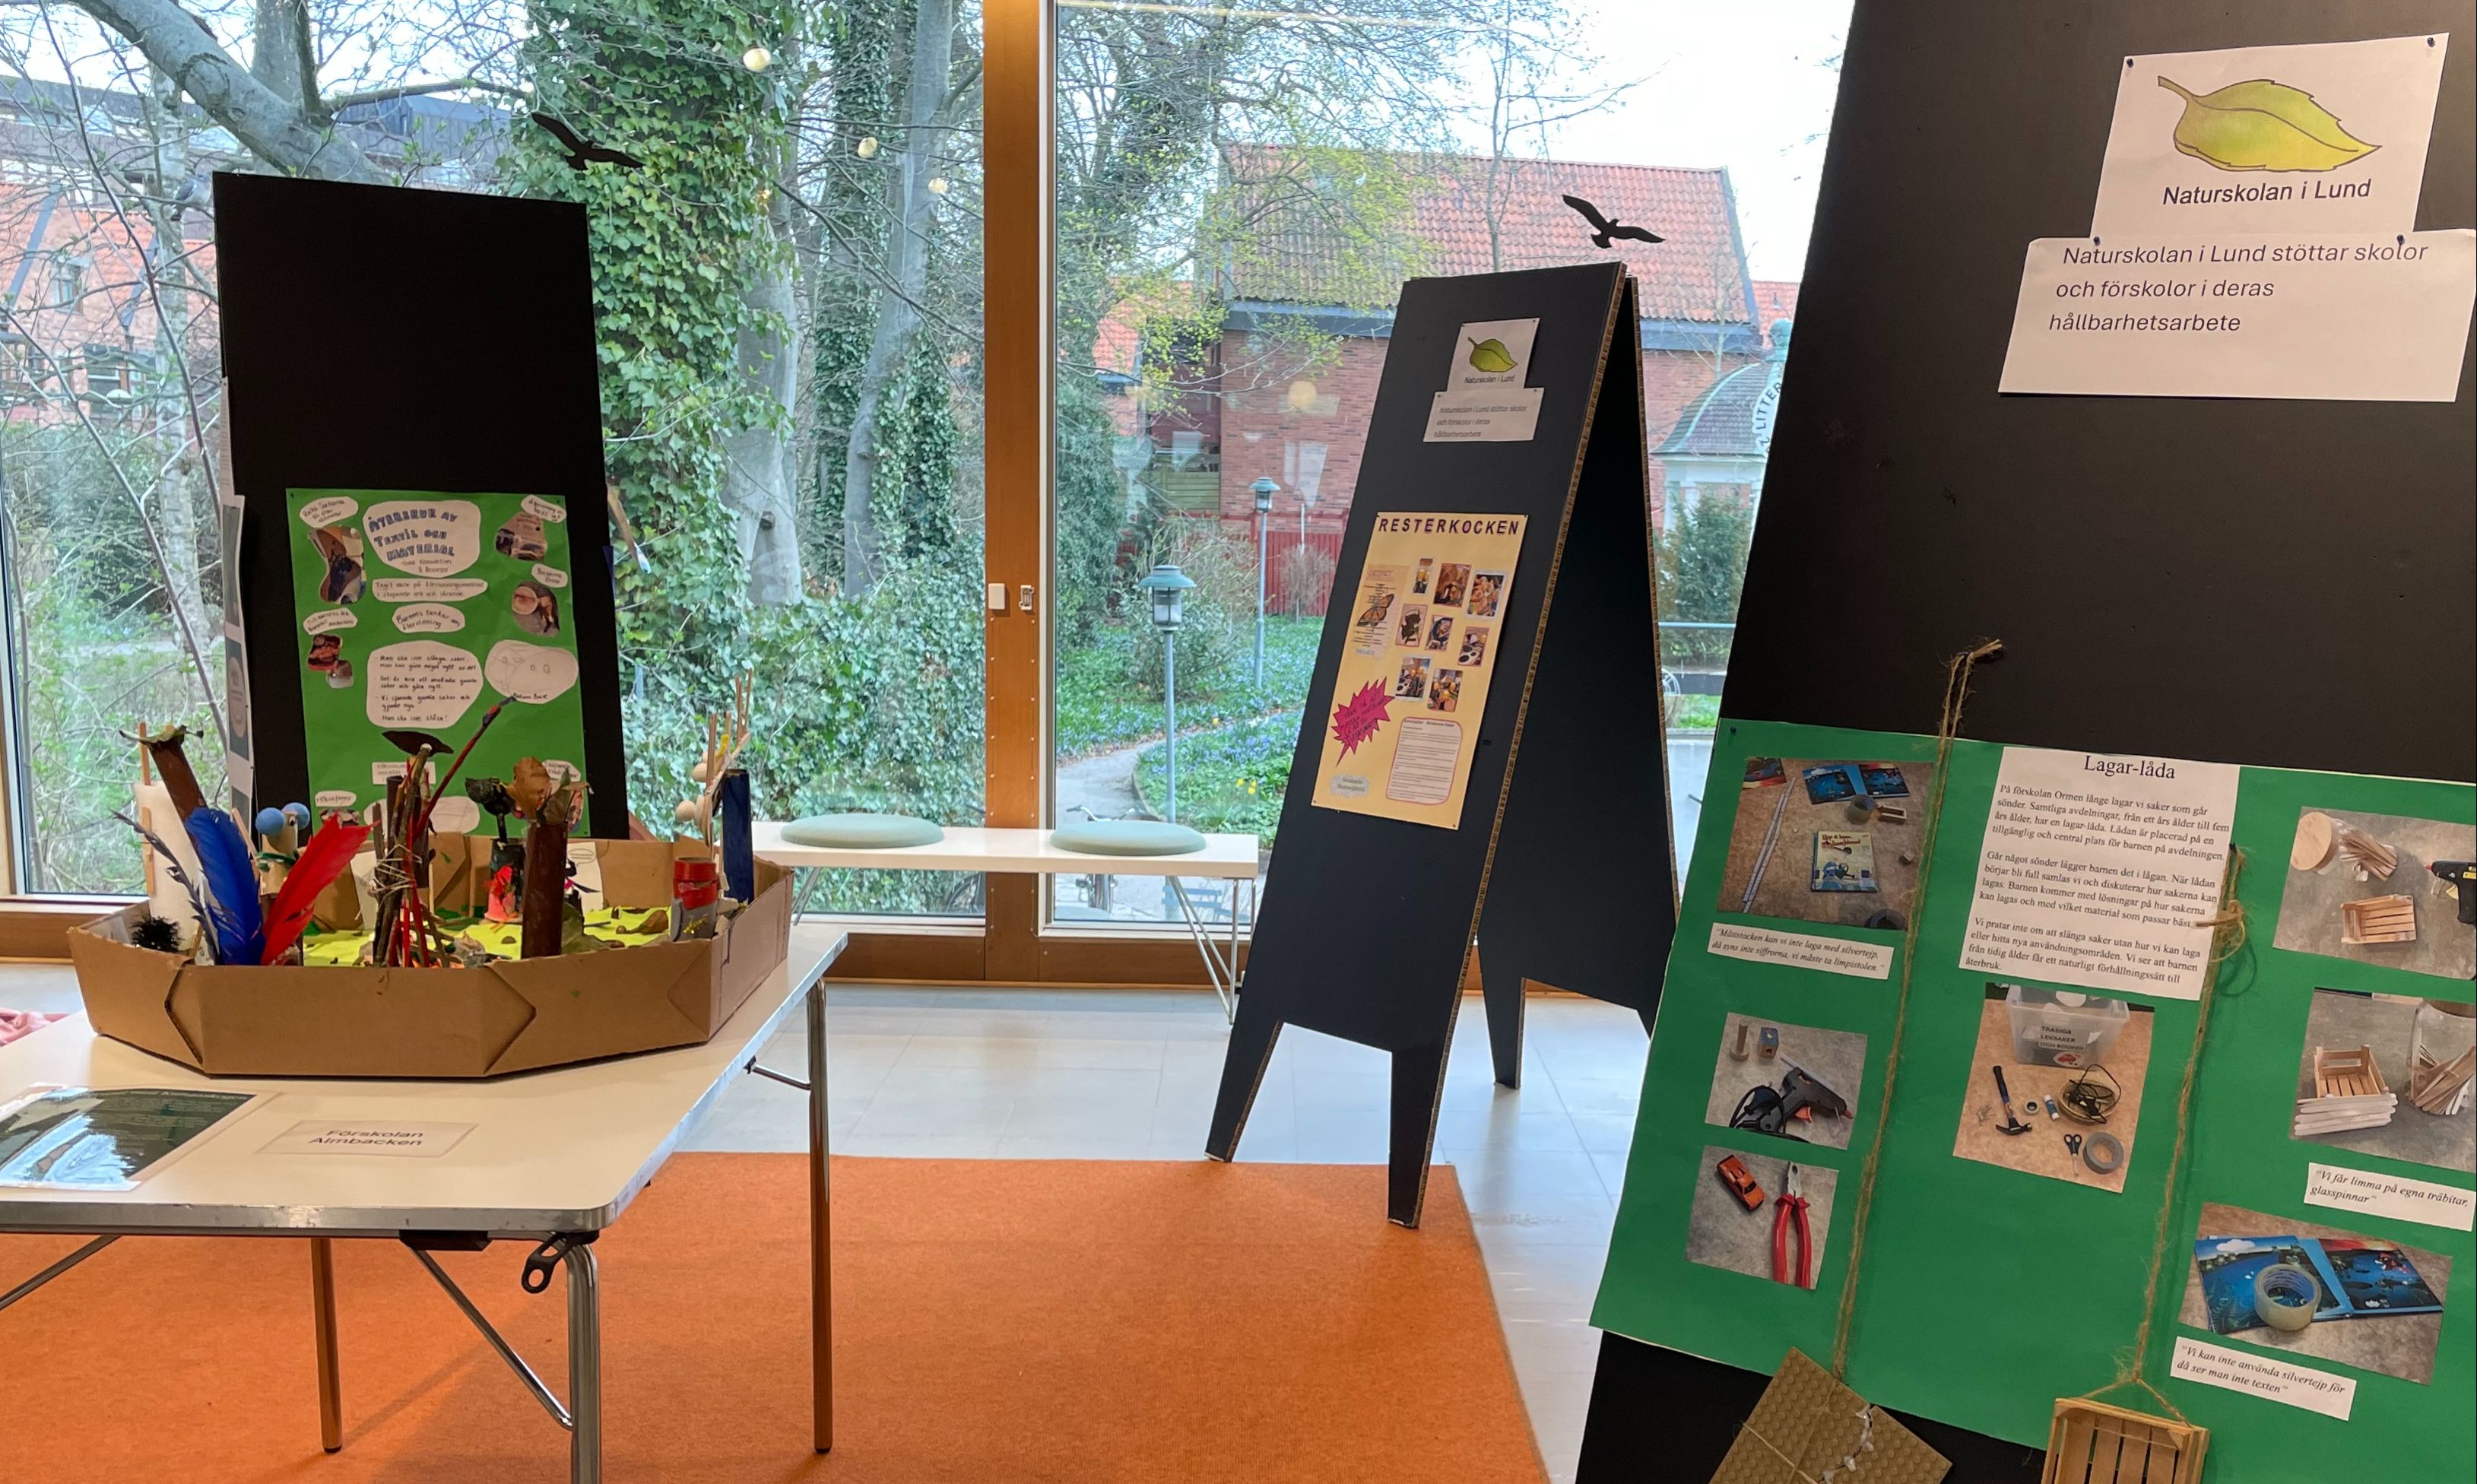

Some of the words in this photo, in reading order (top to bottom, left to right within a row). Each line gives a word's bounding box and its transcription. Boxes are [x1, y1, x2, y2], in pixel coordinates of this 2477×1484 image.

[2162, 182, 2292, 205] Naturskolan
[2301, 180, 2307, 199] i
[2314, 178, 2371, 199] Lund
[2063, 242, 2193, 264] Naturskolan
[2199, 245, 2206, 262] i
[2210, 244, 2266, 262] Lund
[2272, 243, 2349, 262] stöttar
[2354, 238, 2428, 261] skolor
[2056, 281, 2095, 297] och
[2101, 280, 2196, 297] förskolor
[2201, 279, 2208, 296] i
[2212, 279, 2274, 296] deras
[2049, 312, 2241, 331] hållbarhetsarbete
[1378, 518, 1519, 534] RESTERKOCKEN
[387, 544, 455, 561] MATERIAL
[2083, 754, 2175, 779] Lagar-låda
[1999, 784, 2011, 794] På
[2012, 785, 2052, 798] förskolan
[2054, 790, 2083, 801] Ormen
[2085, 794, 2109, 806] långe
[2111, 796, 2134, 808] lagar
[2146, 801, 2171, 811] saker
[2171, 805, 2190, 813] som
[2192, 806, 2208, 817] går
[1994, 810, 2007, 820] års
[2034, 815, 2049, 825] har
[2109, 824, 2137, 836] Lådan
[2139, 828, 2149, 837] är
[2149, 829, 2188, 842] placerad
[2189, 834, 2201, 845] på
[1997, 798, 2026, 809] sönder.
[2029, 801, 2066, 815] Samtliga
[2123, 812, 2141, 823] från
[2156, 816, 2171, 826] års
[2171, 817, 2196, 828] ålder
[2196, 820, 2210, 830] till
[2212, 822, 2229, 832] fem
[1992, 824, 2035, 839] tillgänglig
[2036, 830, 2052, 839] och
[2054, 833, 2083, 843] central
[2084, 836, 2105, 845] plats
[2108, 838, 2121, 848] för
[2123, 839, 2152, 851] barnen
[2154, 844, 2166, 855] på
[2168, 846, 2225, 861] avdelningen.
[1987, 851, 2003, 861] Går
[2004, 853, 2028, 865] något
[2029, 857, 2059, 867] sönder
[2060, 859, 2088, 872] lägger
[2088, 863, 2118, 875] barnen
[2120, 867, 2134, 877] det
[2136, 869, 2140, 878] i
[2171, 874, 2189, 884] När
[2190, 876, 2215, 888] lådan
[1981, 877, 2005, 889] lagas.
[2008, 880, 2038, 893] Barnen
[2040, 884, 2076, 898] kommer
[2076, 891, 2097, 900] med
[2098, 892, 2139, 907] lösningar
[2139, 899, 2152, 909] på
[2153, 900, 2170, 911] hur
[2171, 903, 2206, 915] sakerna
[1984, 863, 2010, 876] börjar
[2011, 867, 2022, 877] bli
[2025, 869, 2040, 879] full
[2041, 873, 2070, 883] samlas
[2082, 877, 2099, 887] och
[2101, 879, 2146, 893] diskuterar
[2146, 885, 2163, 895] hur
[2164, 888, 2199, 900] sakerna
[2200, 892, 2217, 905] kan
[1979, 890, 1994, 901] kan
[1996, 893, 2018, 905] lagas
[2019, 897, 2035, 906] och
[2037, 900, 2057, 909] med
[2058, 902, 2082, 912] vilket
[2083, 906, 2120, 918] material
[2121, 912, 2140, 921] som
[2141, 915, 2171, 925] passar
[1711, 940, 1722, 952] då
[1721, 943, 1739, 952] syns
[1740, 944, 1755, 954] inte
[1791, 952, 1800, 960] vi
[1800, 954, 1823, 965] måste
[1823, 956, 1832, 965] ta
[1763, 934, 1778, 943] kan
[1787, 937, 1803, 947] inte
[1803, 940, 1822, 951] laga
[1822, 942, 1841, 953] med
[307, 1137, 422, 1146] Almbacken
[325, 1130, 423, 1138] Förskolan
[2331, 1173, 2349, 1184] får
[2350, 1175, 2382, 1191] limma
[2381, 1183, 2398, 1194] på
[2399, 1185, 2425, 1199] egna
[2427, 1191, 2469, 1208] träbitar,
[2176, 1359, 2190, 1371] då
[2190, 1365, 2207, 1375] ser
[2208, 1369, 2229, 1380] man
[2231, 1372, 2250, 1385] inte
[2197, 1349, 2216, 1362] kan
[2217, 1354, 2237, 1367] inte
[2238, 1361, 2280, 1378] använda
[2281, 1371, 2328, 1392] silvertejp
[2326, 1380, 2345, 1394] för
